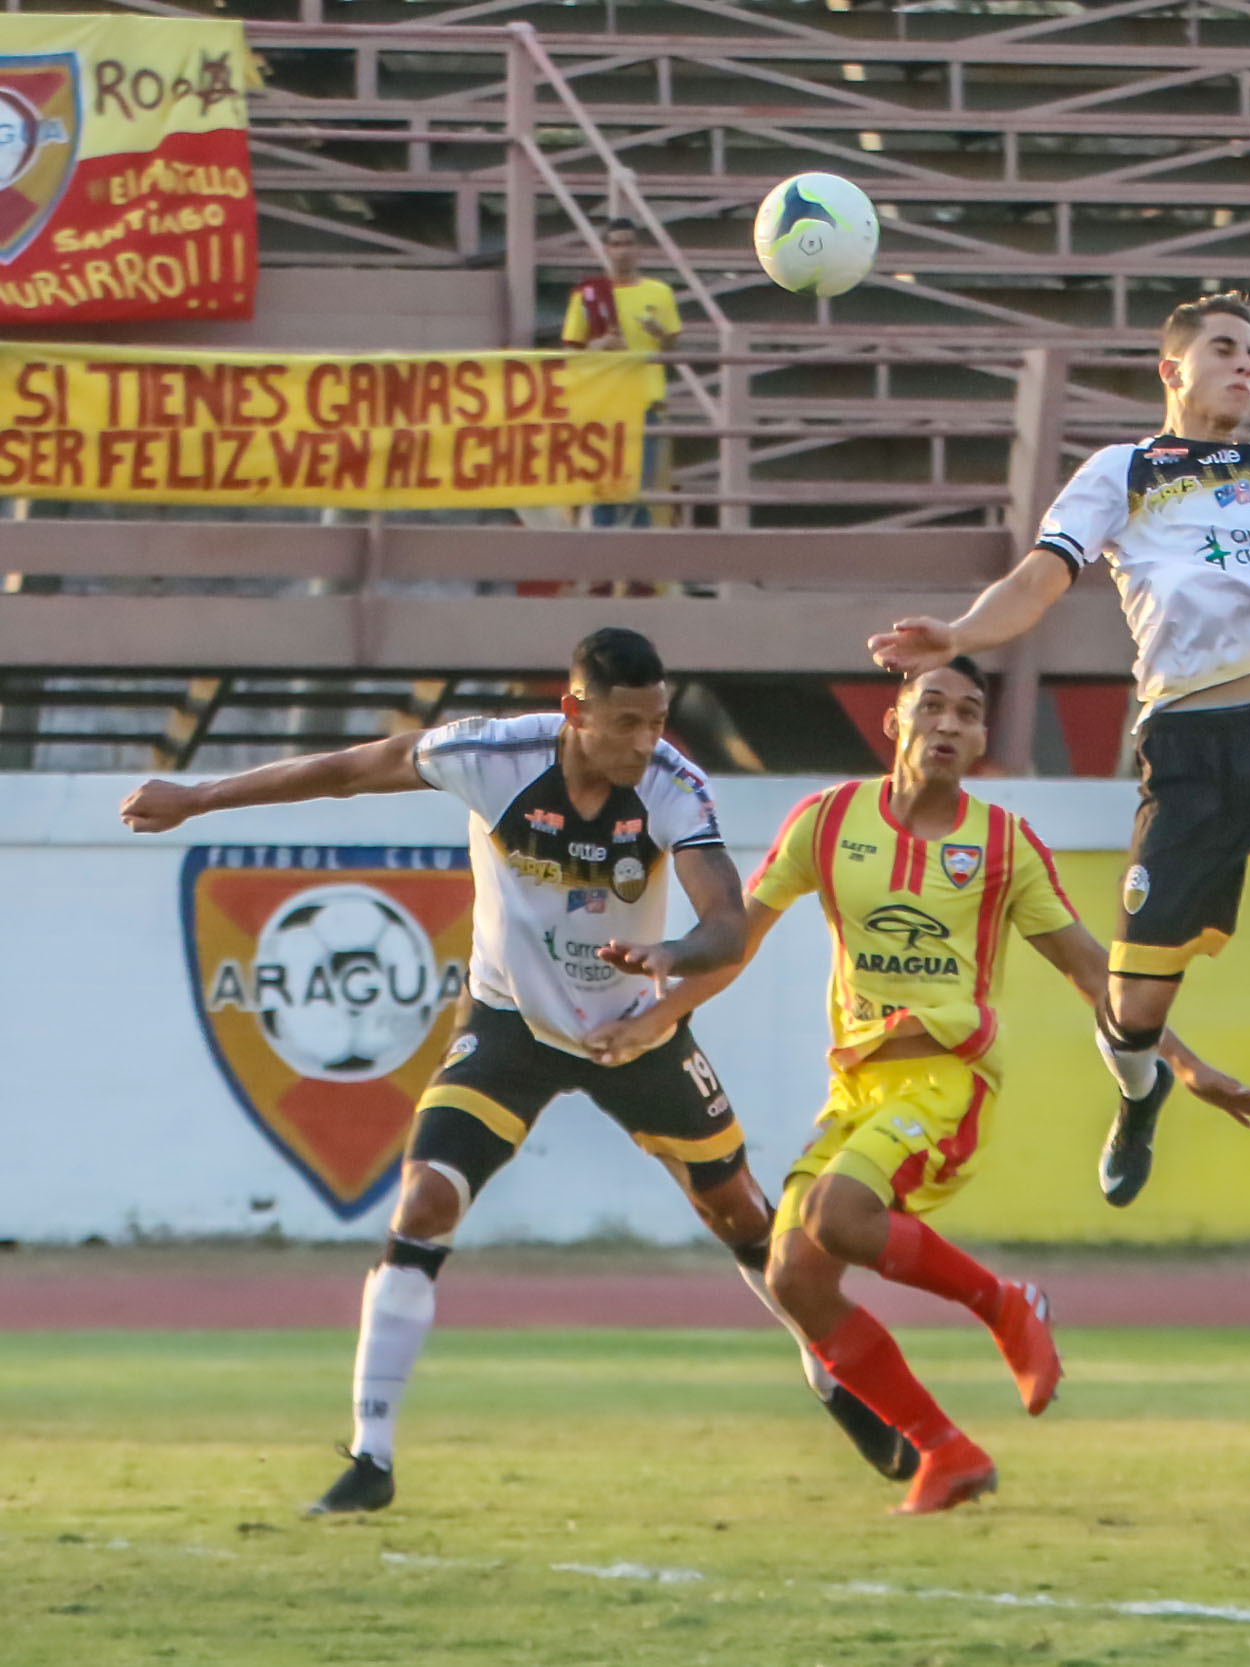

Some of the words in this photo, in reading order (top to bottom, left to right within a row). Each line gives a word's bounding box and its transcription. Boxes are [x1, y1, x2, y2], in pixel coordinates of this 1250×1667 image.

[13, 361, 69, 427] SI
[86, 361, 289, 428] TIENES
[306, 360, 489, 430] GANAS
[503, 358, 570, 421] DE
[0, 428, 84, 487] SER
[384, 847, 452, 871] CLU
[209, 962, 464, 1007] ARAGUA
[855, 952, 960, 976] ARAGUA
[682, 1050, 718, 1098] 19
